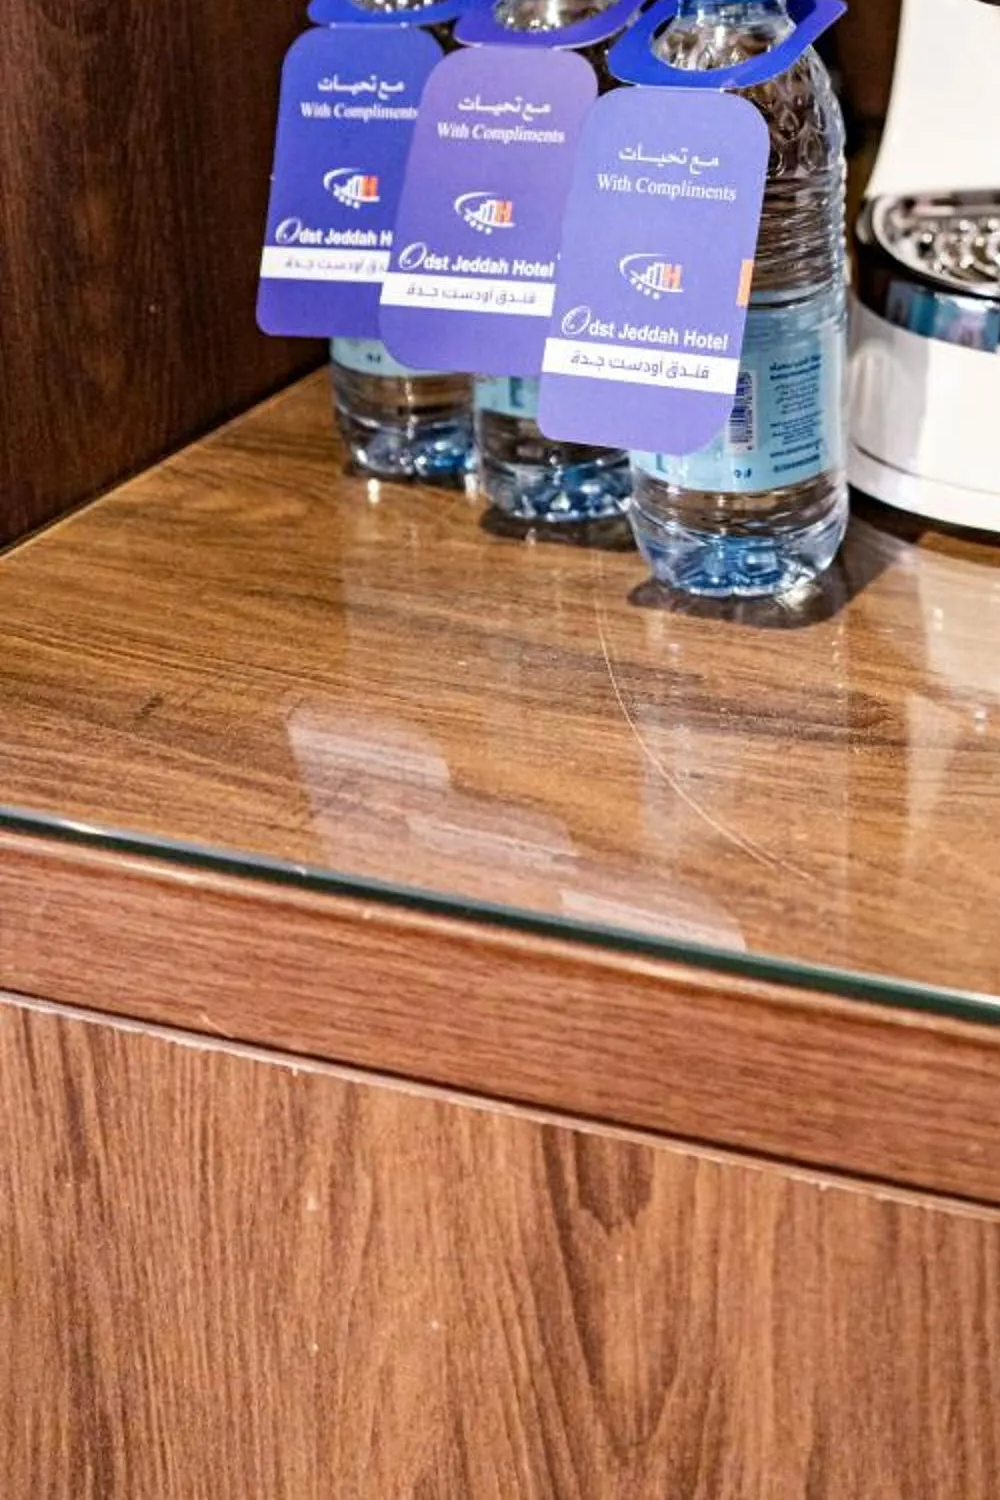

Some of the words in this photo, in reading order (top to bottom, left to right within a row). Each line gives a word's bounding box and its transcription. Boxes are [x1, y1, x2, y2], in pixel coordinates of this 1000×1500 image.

[300, 101, 331, 119] With
[437, 122, 470, 141] With
[471, 123, 566, 145] Compliments
[596, 173, 633, 193] With
[635, 177, 738, 203] Compliments
[324, 229, 377, 246] Jeddah
[452, 256, 509, 275] Jeddah
[512, 260, 555, 279] Hotel
[617, 325, 679, 346] Jeddah
[683, 330, 729, 351] Hotel
